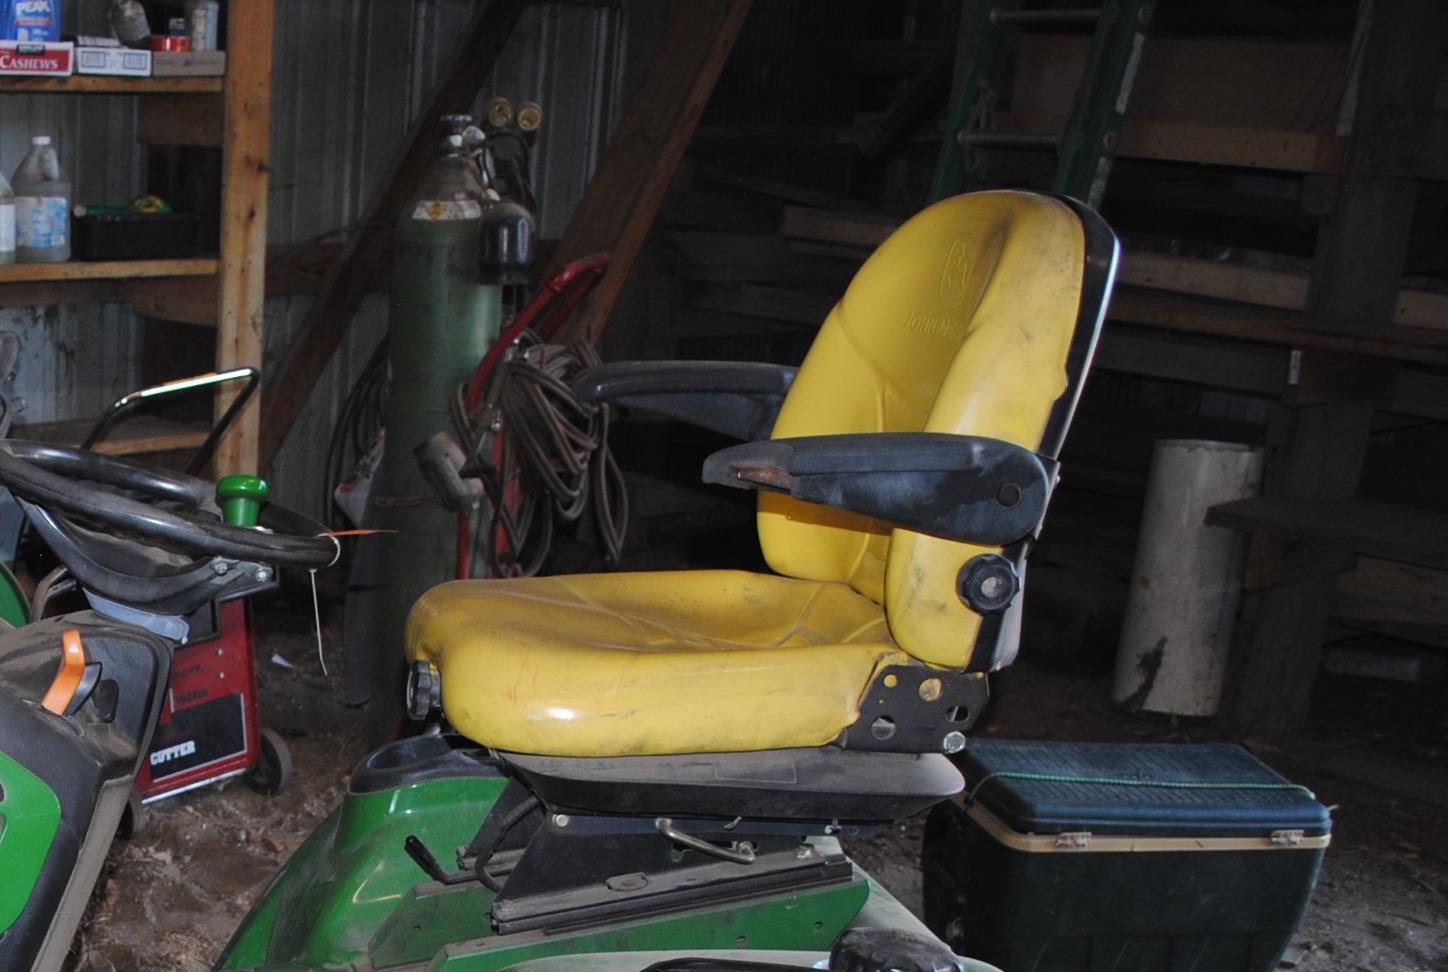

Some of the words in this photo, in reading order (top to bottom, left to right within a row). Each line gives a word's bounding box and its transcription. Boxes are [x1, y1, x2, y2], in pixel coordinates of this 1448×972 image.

[16, 0, 50, 17] PEAK
[0, 54, 58, 70] CASHEWS
[150, 739, 196, 766] CUTTER
